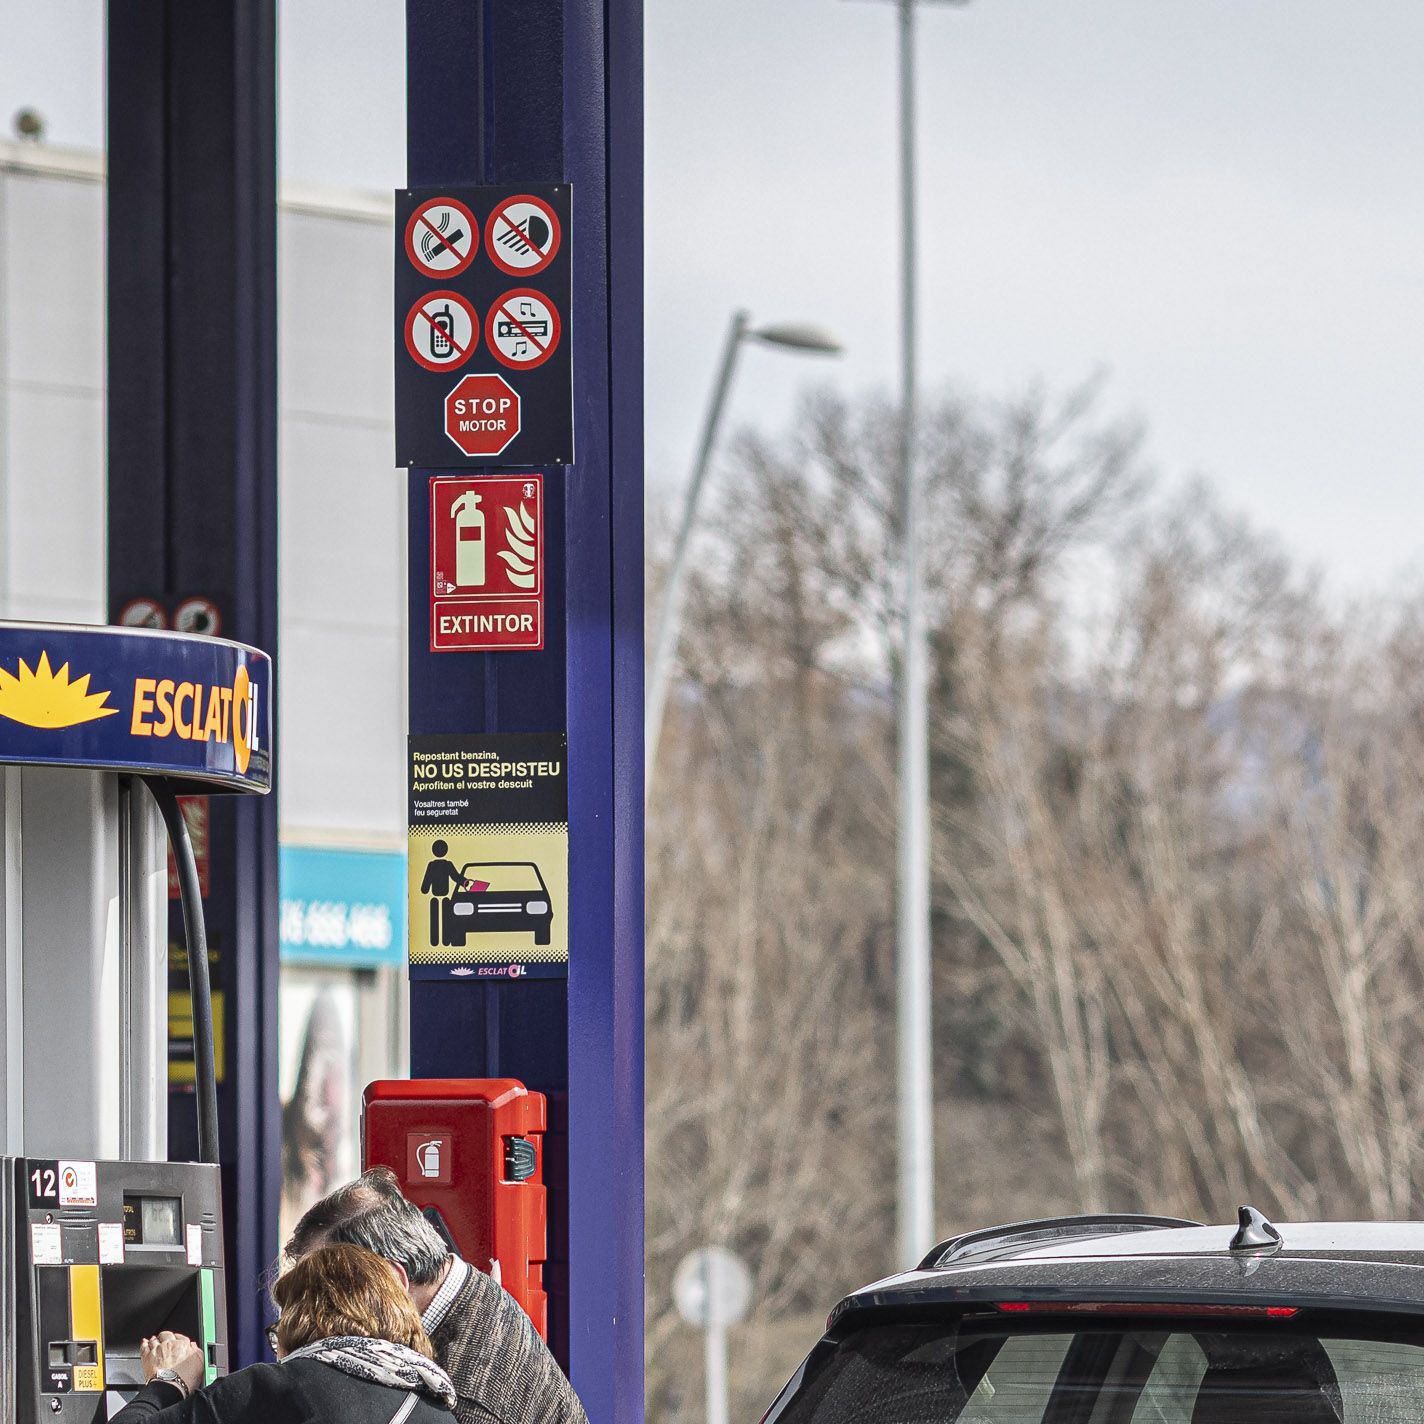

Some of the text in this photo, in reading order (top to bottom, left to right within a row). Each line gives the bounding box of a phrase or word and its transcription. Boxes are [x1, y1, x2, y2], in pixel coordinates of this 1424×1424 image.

[454, 397, 511, 416] STOP
[459, 420, 507, 433] MOTOR
[440, 614, 533, 634] EXTINTOR
[413, 750, 500, 761] Repostant benzina,
[413, 761, 560, 779] NO US DESPISTEU
[412, 779, 533, 791] Aprofiten el vostre descuit
[413, 799, 469, 809] Vosaltres també
[414, 808, 459, 818] feu seguretat
[31, 1169, 56, 1197] 12
[78, 1369, 97, 1378] DIESEL
[57, 1381, 63, 1389] A
